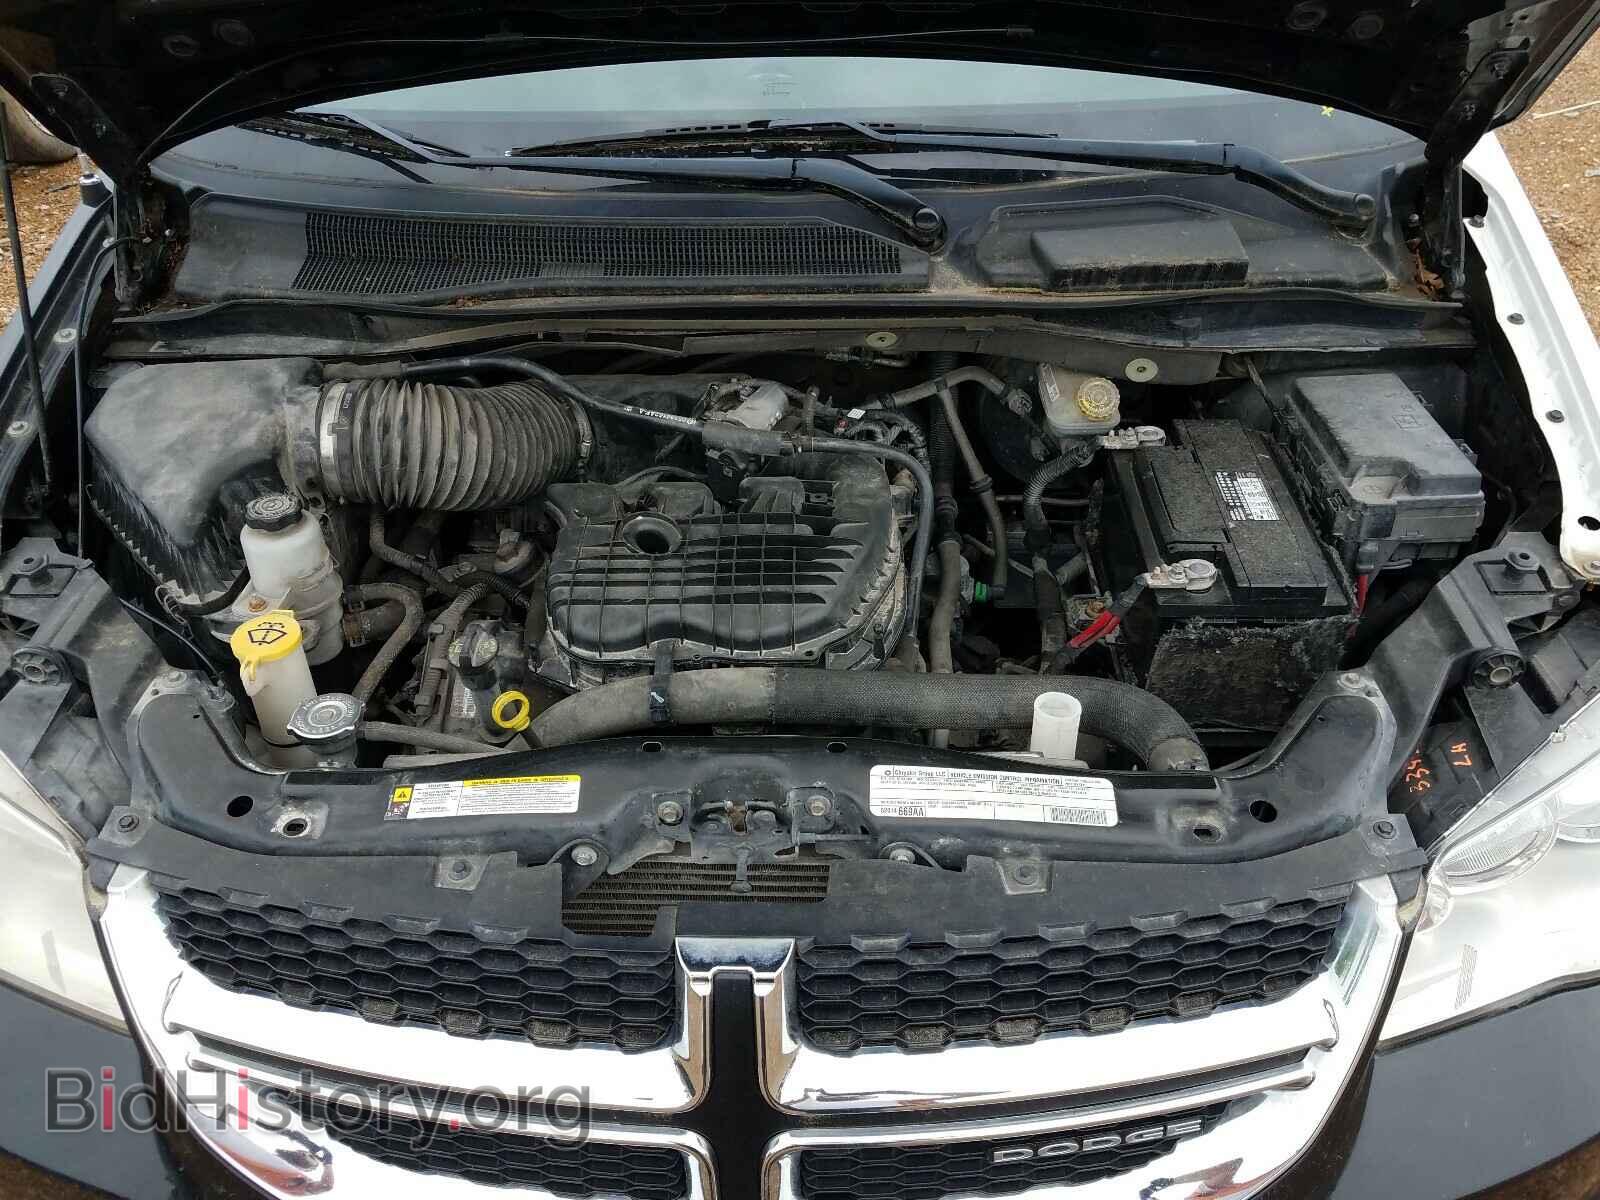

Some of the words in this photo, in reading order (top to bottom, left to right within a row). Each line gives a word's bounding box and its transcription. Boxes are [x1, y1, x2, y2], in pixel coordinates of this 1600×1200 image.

[935, 770, 946, 778] LLC
[898, 806, 924, 817] 669AA
[993, 1119, 1202, 1163] DODGE
